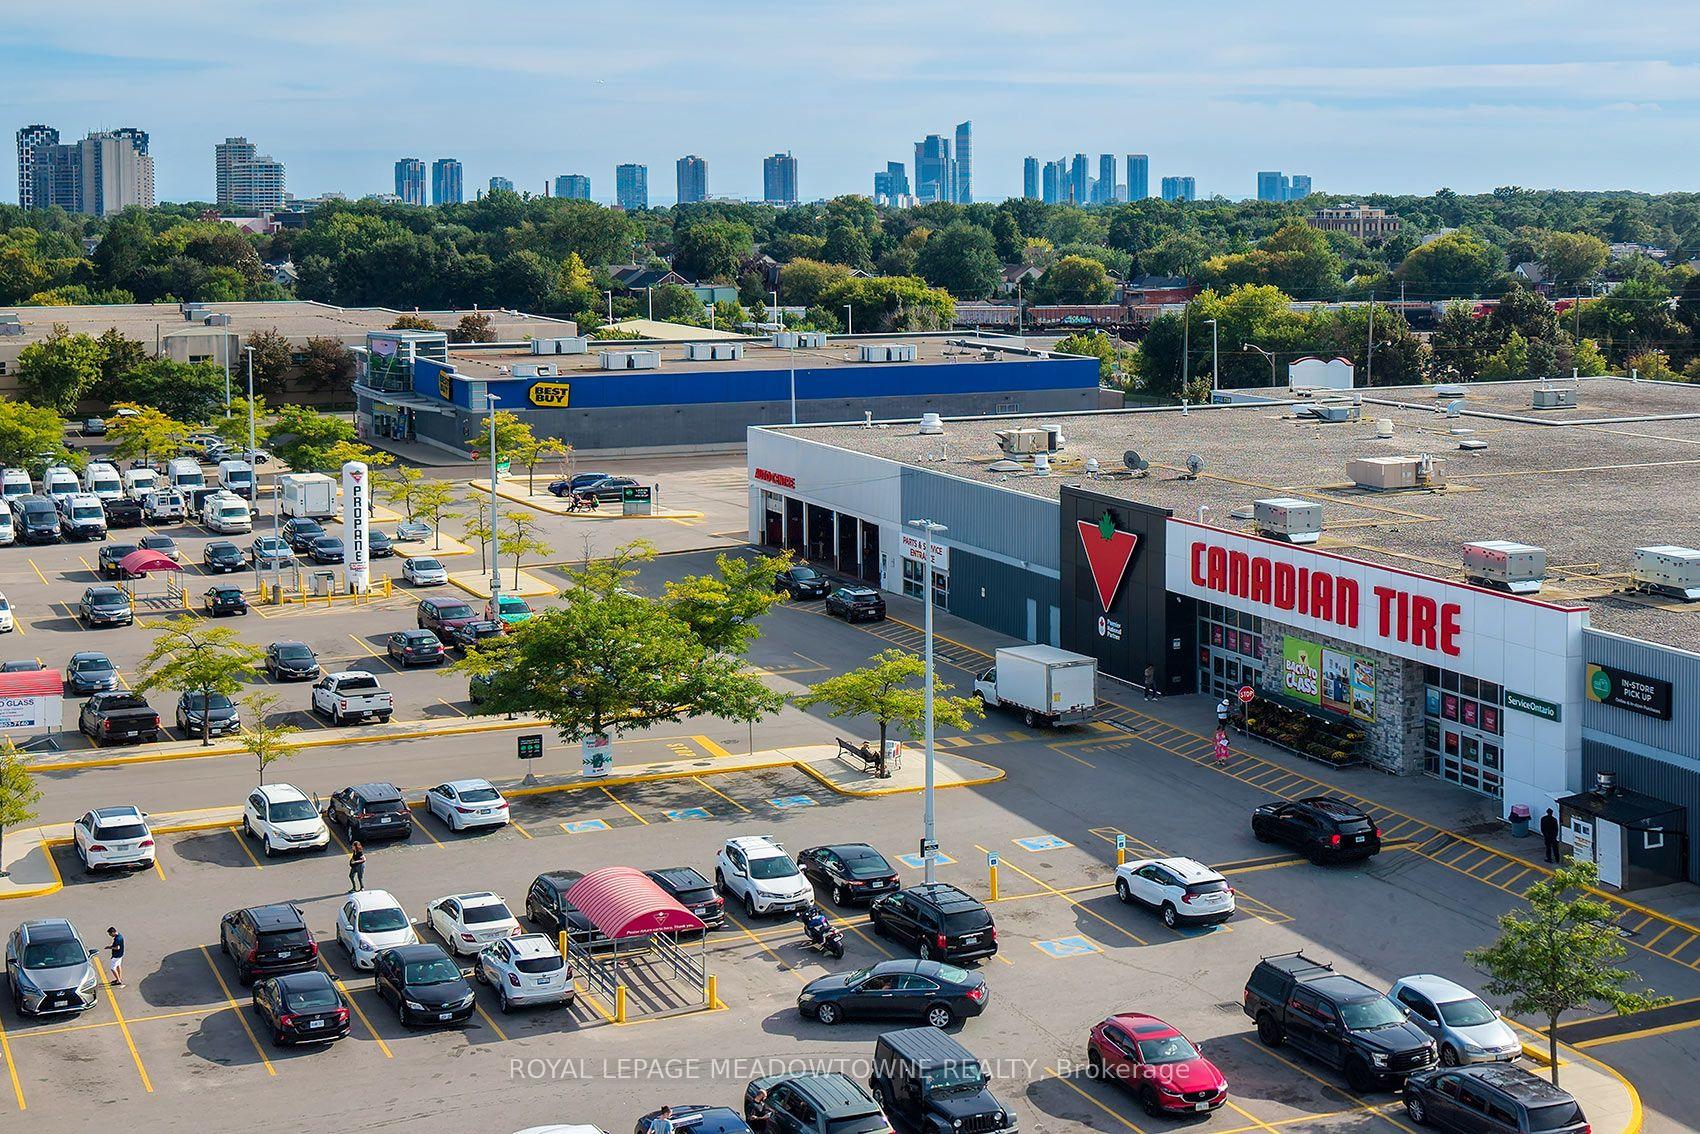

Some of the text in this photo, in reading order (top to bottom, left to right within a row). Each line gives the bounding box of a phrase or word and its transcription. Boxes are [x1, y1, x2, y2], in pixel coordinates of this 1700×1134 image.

[535, 386, 568, 395] BEST
[535, 394, 565, 403] BUY
[353, 485, 363, 561] PROPANE
[902, 536, 918, 548] PARTS
[1190, 541, 1461, 657] CANADIAN TIRE
[1286, 659, 1306, 675] BACK
[1286, 672, 1318, 696] CLASS
[1621, 678, 1655, 695] IN-STORE
[1623, 688, 1652, 702] PICK UP
[6, 699, 35, 708] GLASS
[1507, 695, 1555, 717] ServiceOntario
